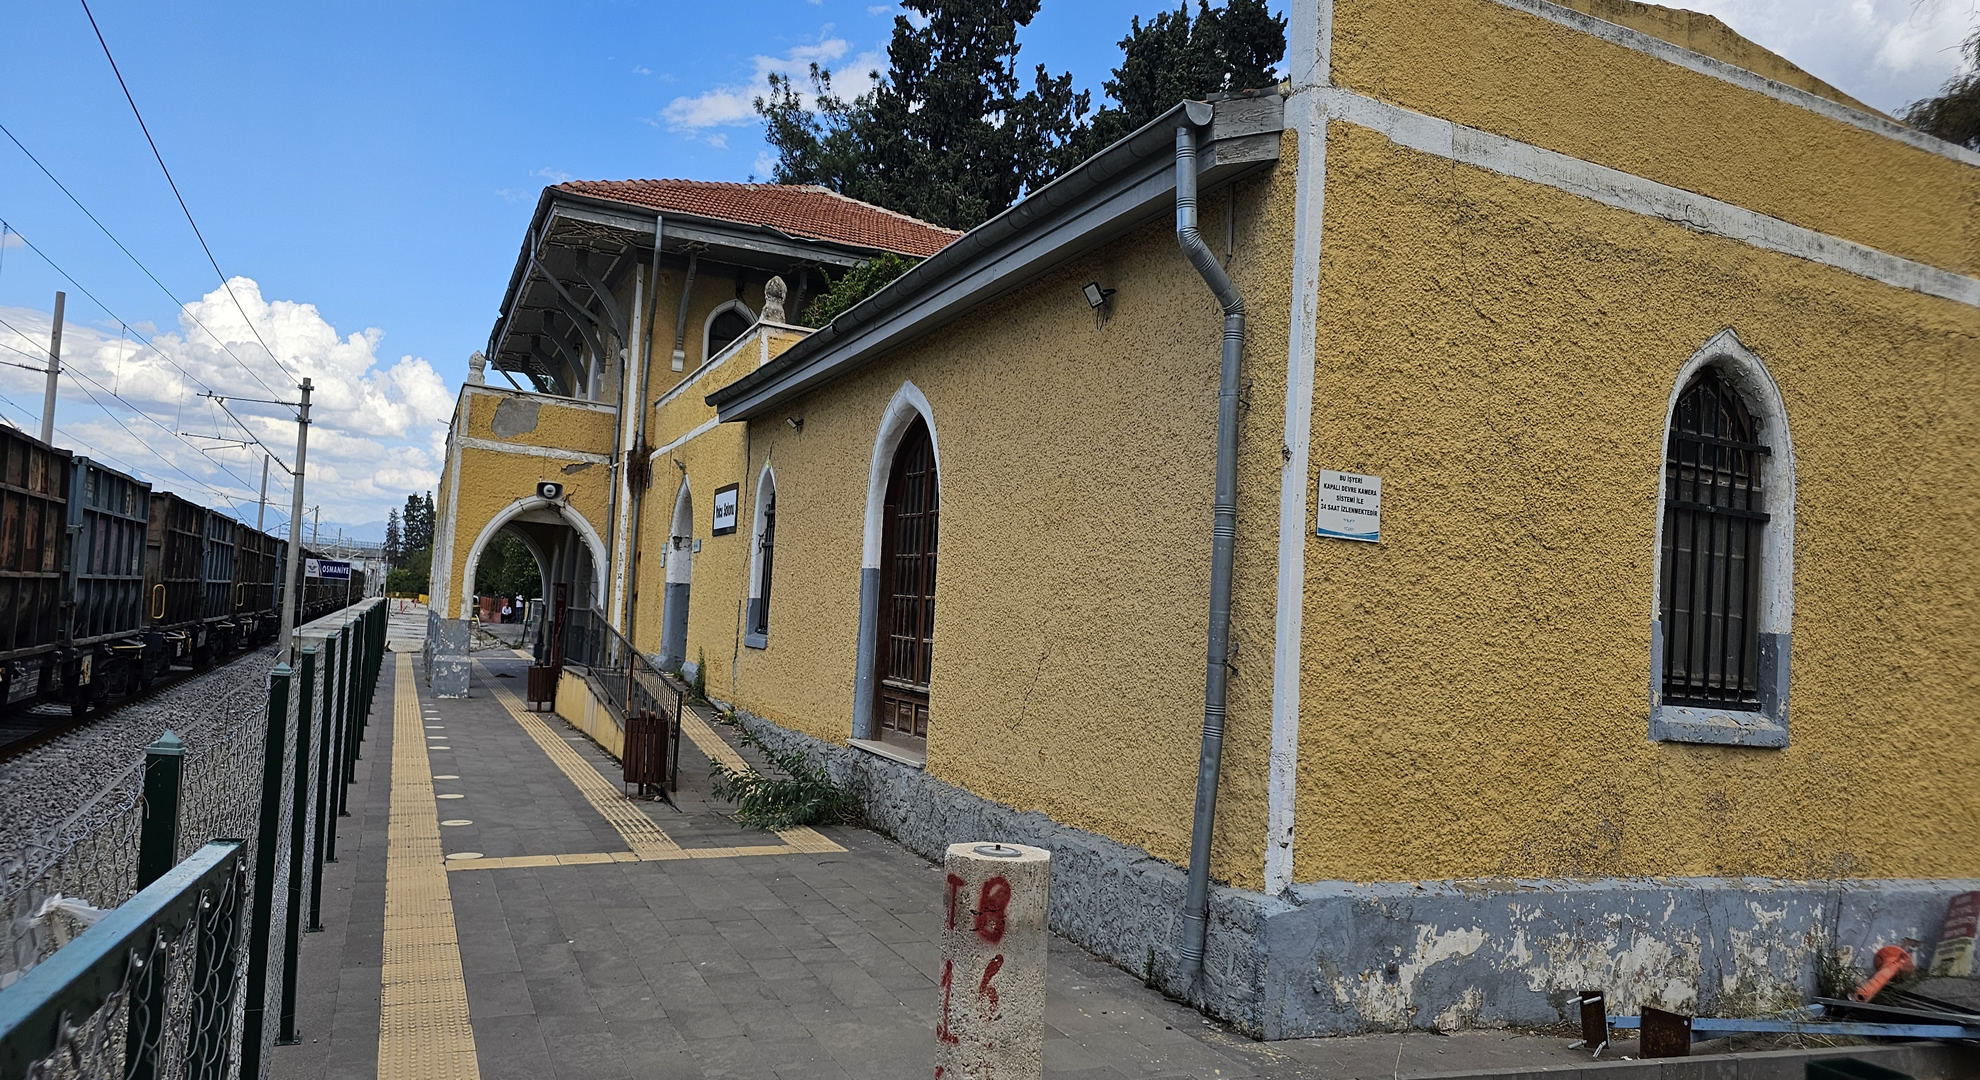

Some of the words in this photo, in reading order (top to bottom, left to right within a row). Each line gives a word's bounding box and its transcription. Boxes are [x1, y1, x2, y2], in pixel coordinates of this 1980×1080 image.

[1347, 475, 1362, 484] İŞYERİ
[1324, 483, 1341, 491] KAPALI
[1358, 488, 1377, 496] KAMERA
[1336, 494, 1355, 503] SİSTEMİ
[1341, 505, 1378, 516] İZLENMEKTEDİR
[322, 565, 349, 574] OSMANİYE
